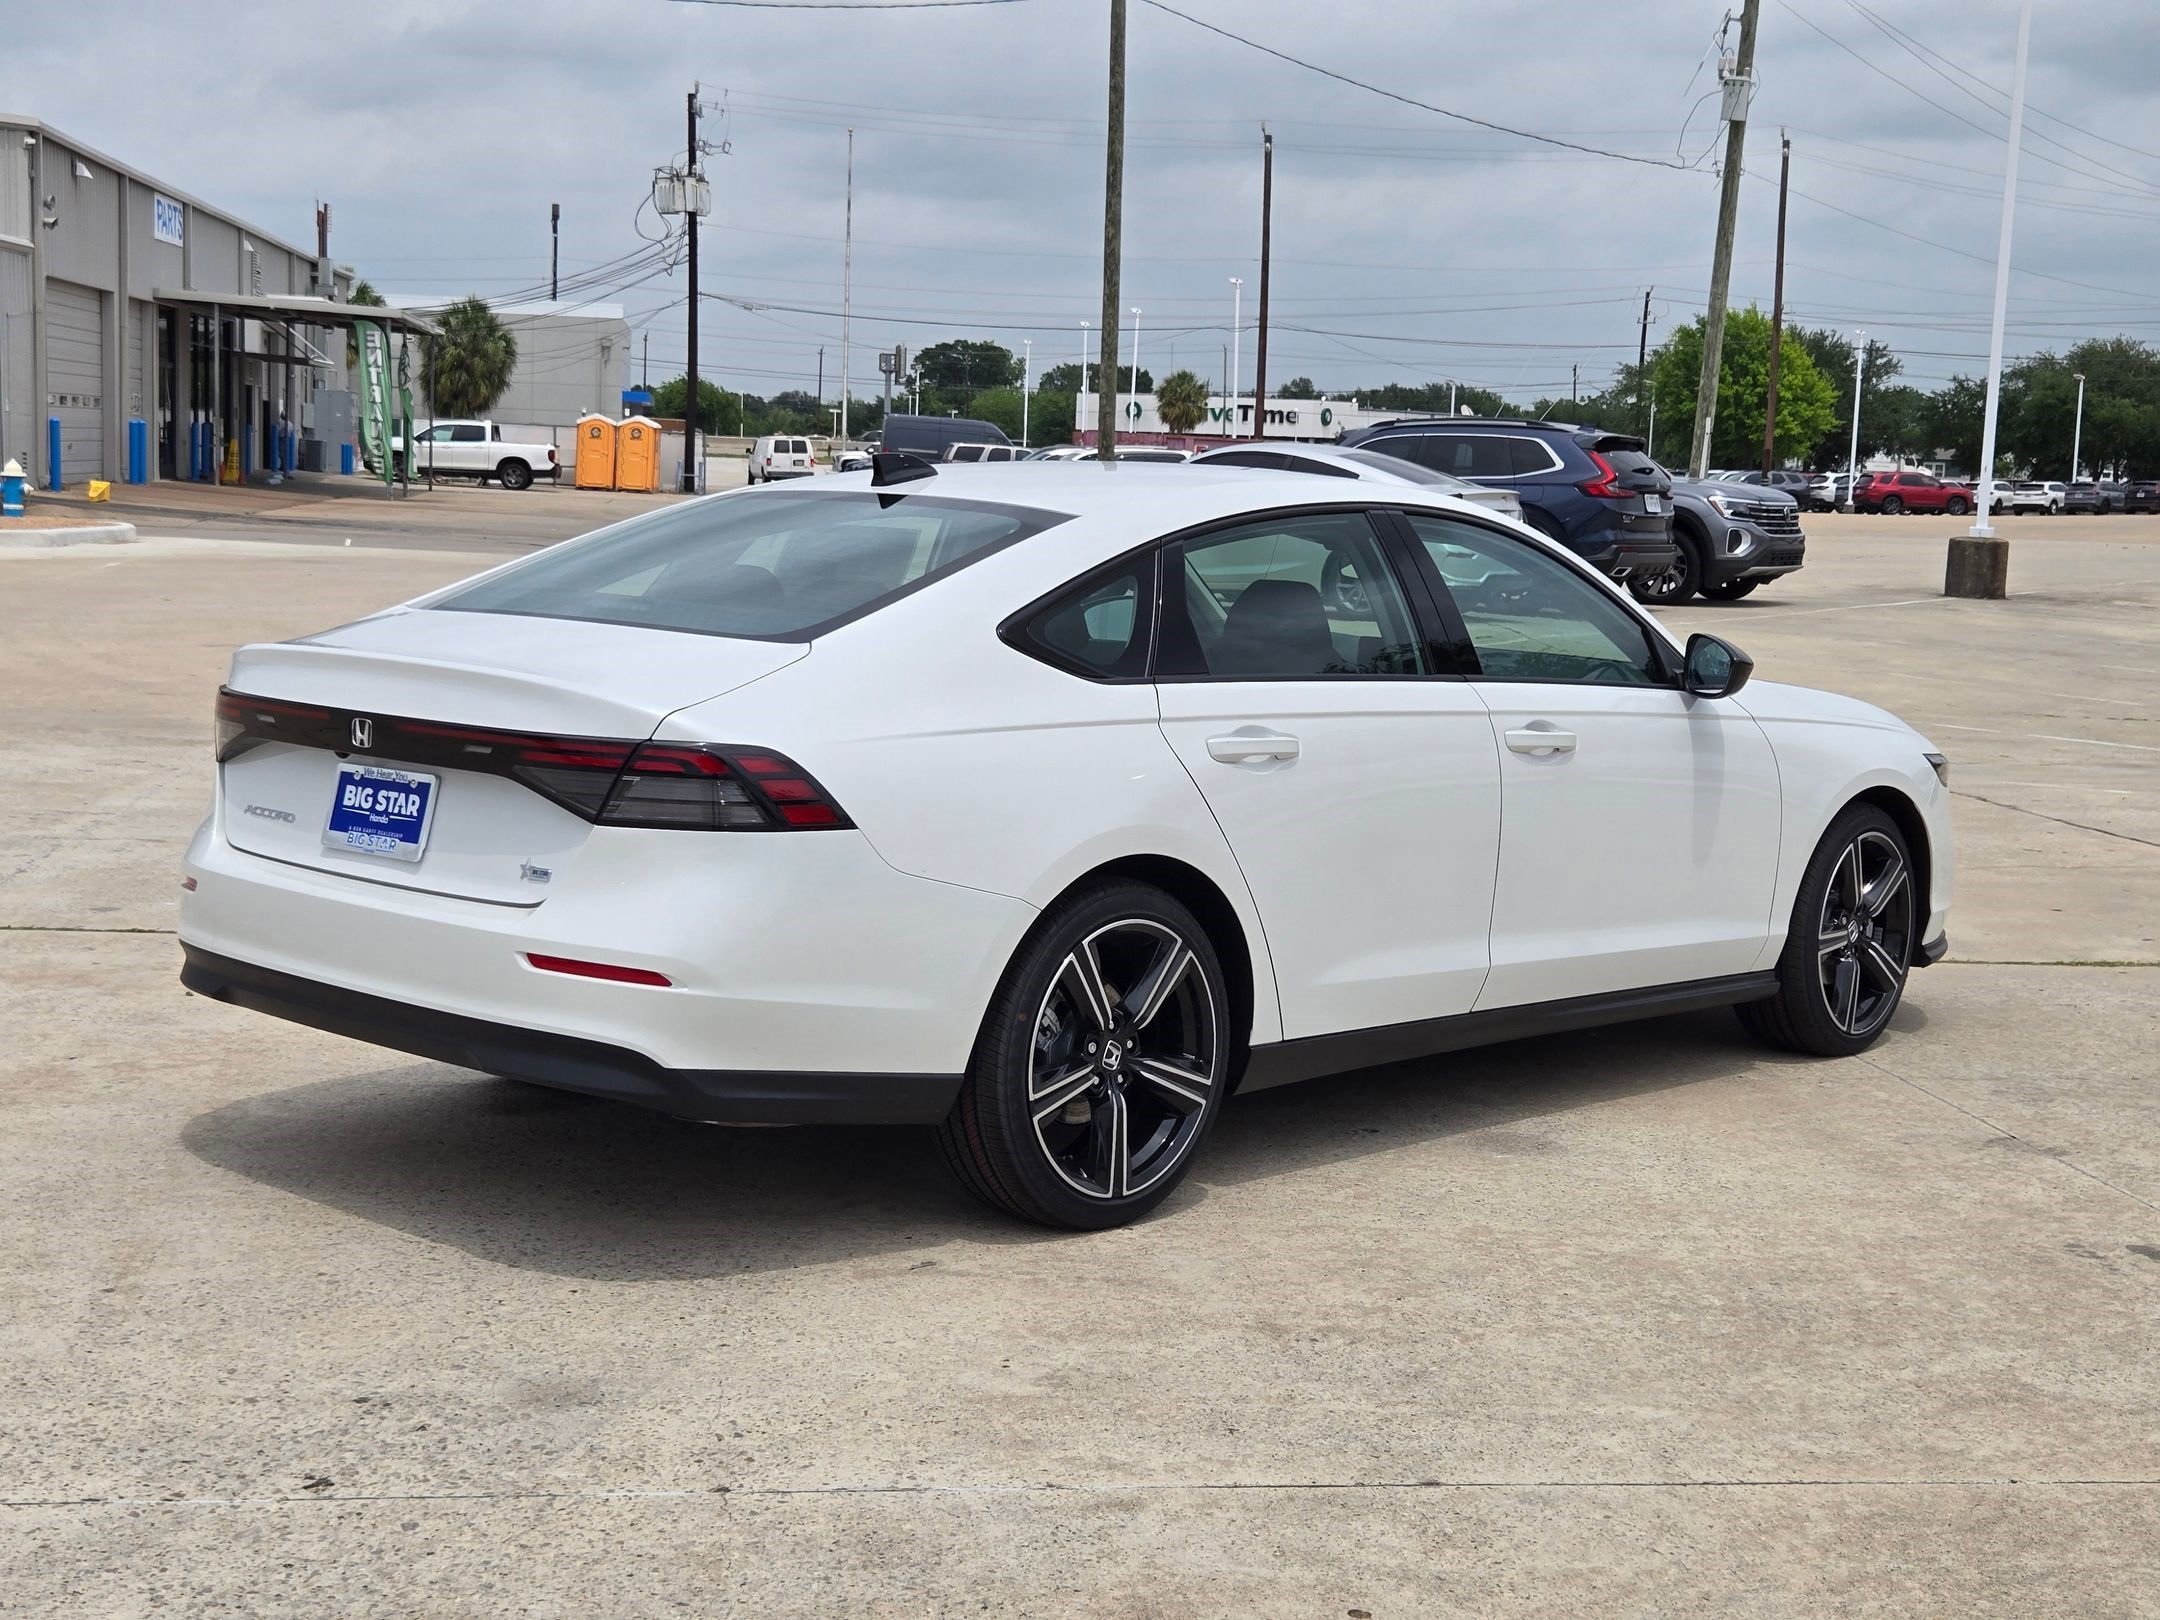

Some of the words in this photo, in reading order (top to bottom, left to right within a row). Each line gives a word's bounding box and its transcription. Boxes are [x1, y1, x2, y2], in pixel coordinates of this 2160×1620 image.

[157, 198, 183, 241] PARTS
[363, 767, 376, 778] We
[376, 768, 394, 779] Hear
[394, 770, 409, 782] You
[342, 784, 374, 809] BIG
[374, 789, 421, 817] STAR
[243, 804, 296, 824] ACCORD
[369, 812, 389, 824] Honda
[346, 832, 365, 845] BIG
[367, 834, 397, 851] STAR
